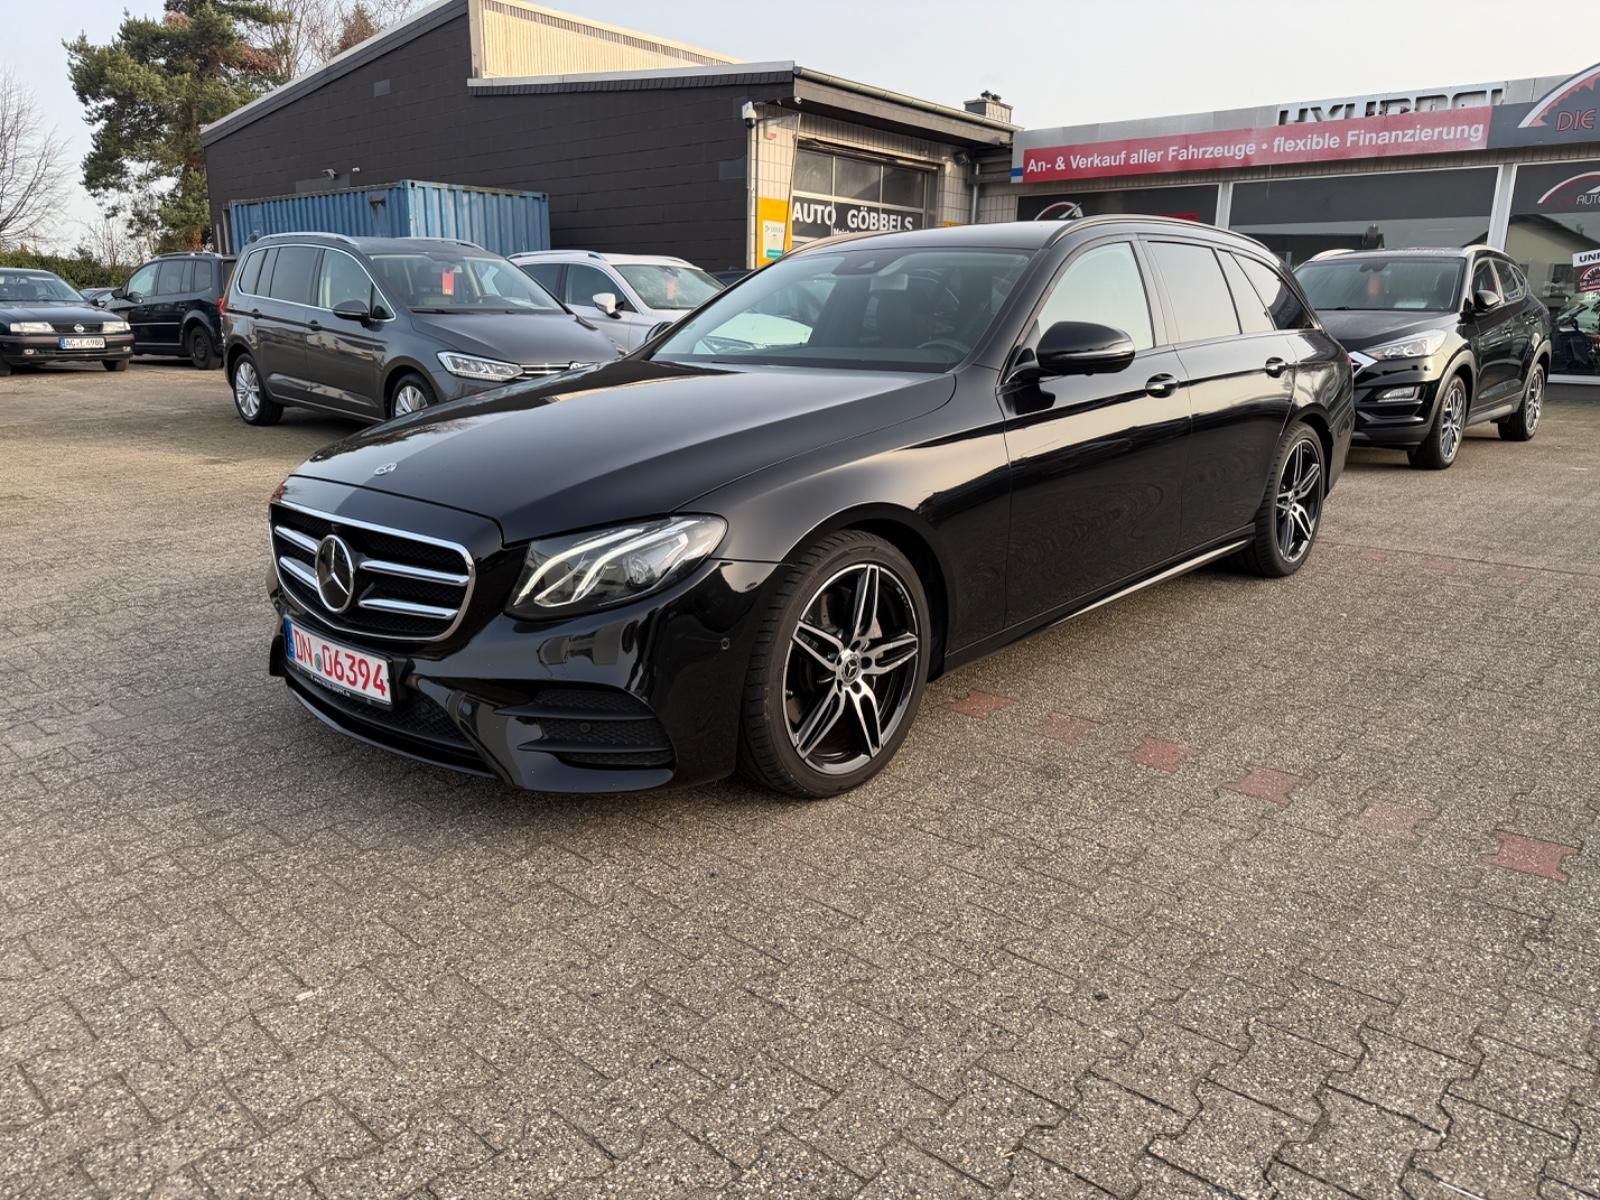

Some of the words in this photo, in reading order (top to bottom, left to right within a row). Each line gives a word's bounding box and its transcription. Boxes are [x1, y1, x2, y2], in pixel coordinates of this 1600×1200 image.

[1555, 108, 1597, 131] DIE
[1027, 157, 1052, 173] An-
[1055, 155, 1066, 170] &
[1070, 153, 1126, 169] Verkauf
[1129, 148, 1164, 163] aller
[1168, 142, 1256, 161] Fahrzeuge
[1273, 132, 1340, 152] flexible
[1346, 123, 1484, 147] Finanzierung
[792, 202, 836, 226] AUTO
[847, 207, 913, 231] GÖBBELS
[294, 628, 313, 667] DN
[322, 644, 386, 696] 06394
